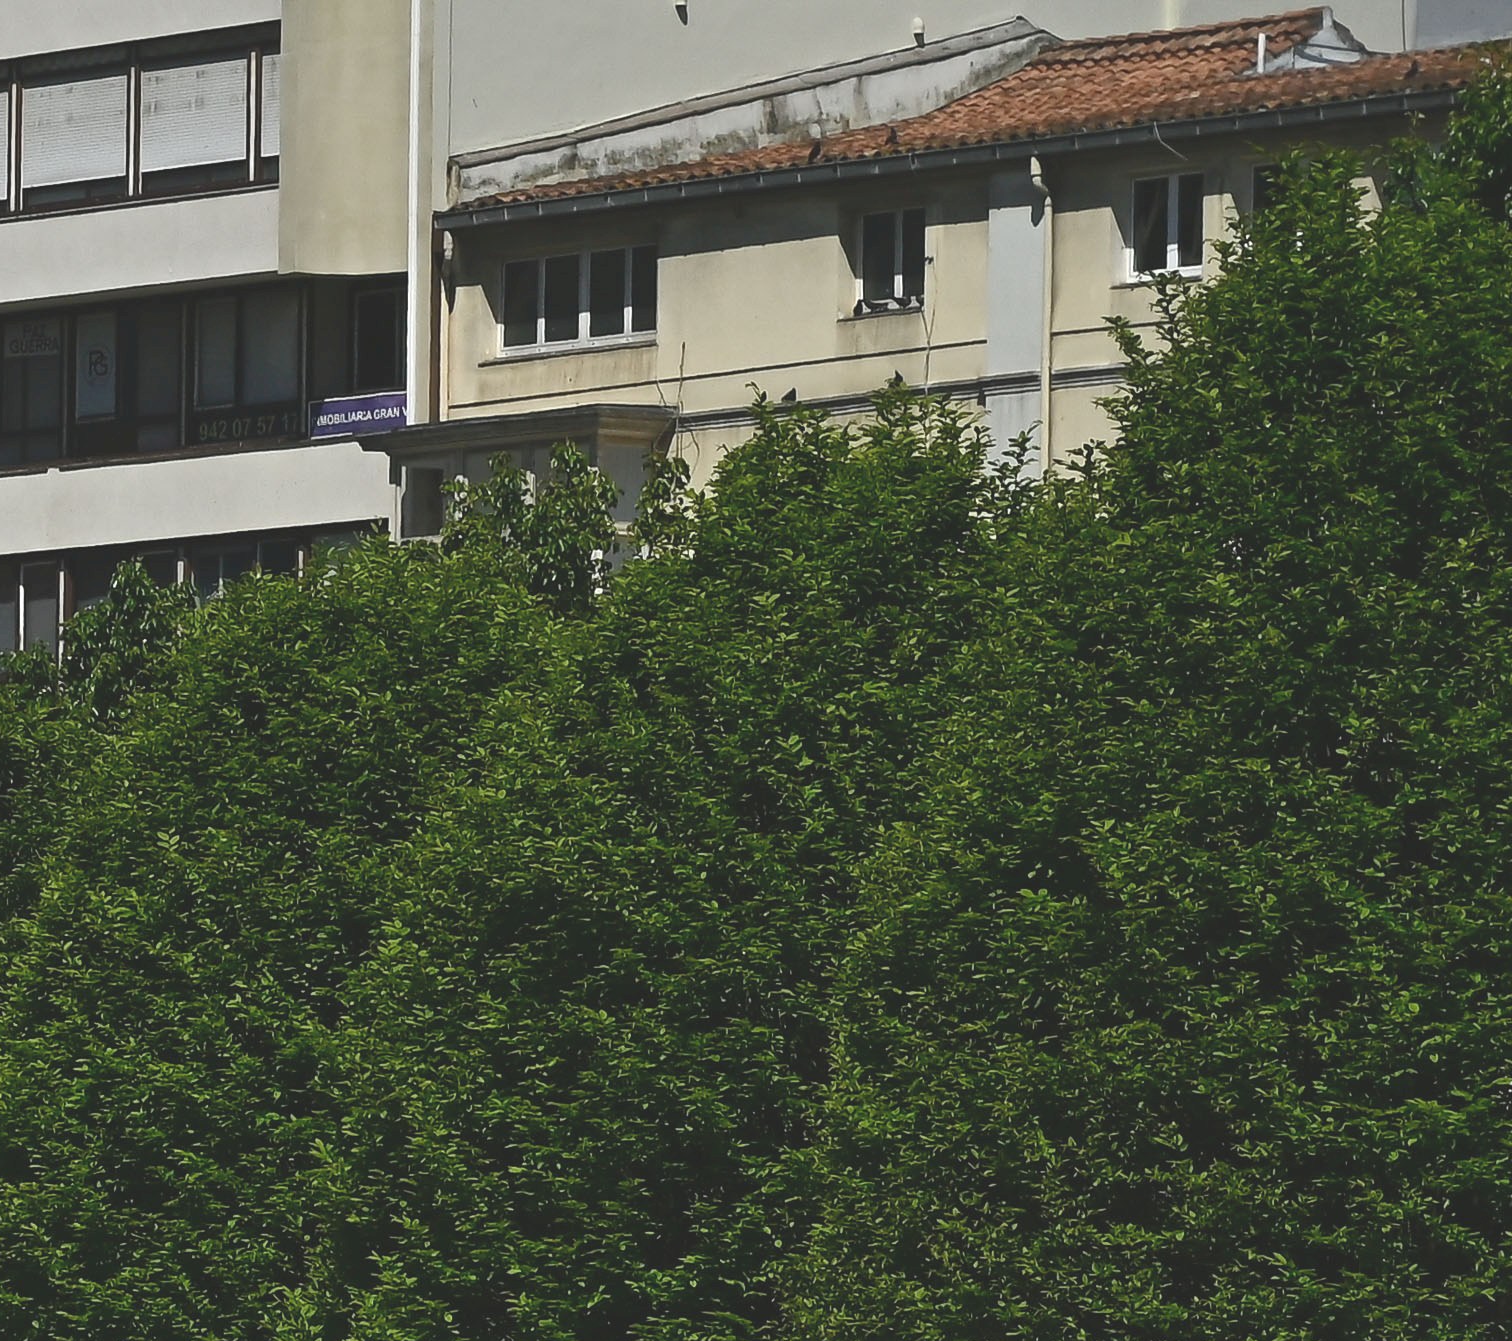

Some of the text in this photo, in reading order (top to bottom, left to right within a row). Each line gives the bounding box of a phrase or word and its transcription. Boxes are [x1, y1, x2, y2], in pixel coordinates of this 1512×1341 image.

[373, 407, 400, 421] GRAN
[199, 420, 227, 440] 942
[232, 418, 252, 438] 07
[257, 416, 275, 434] 57
